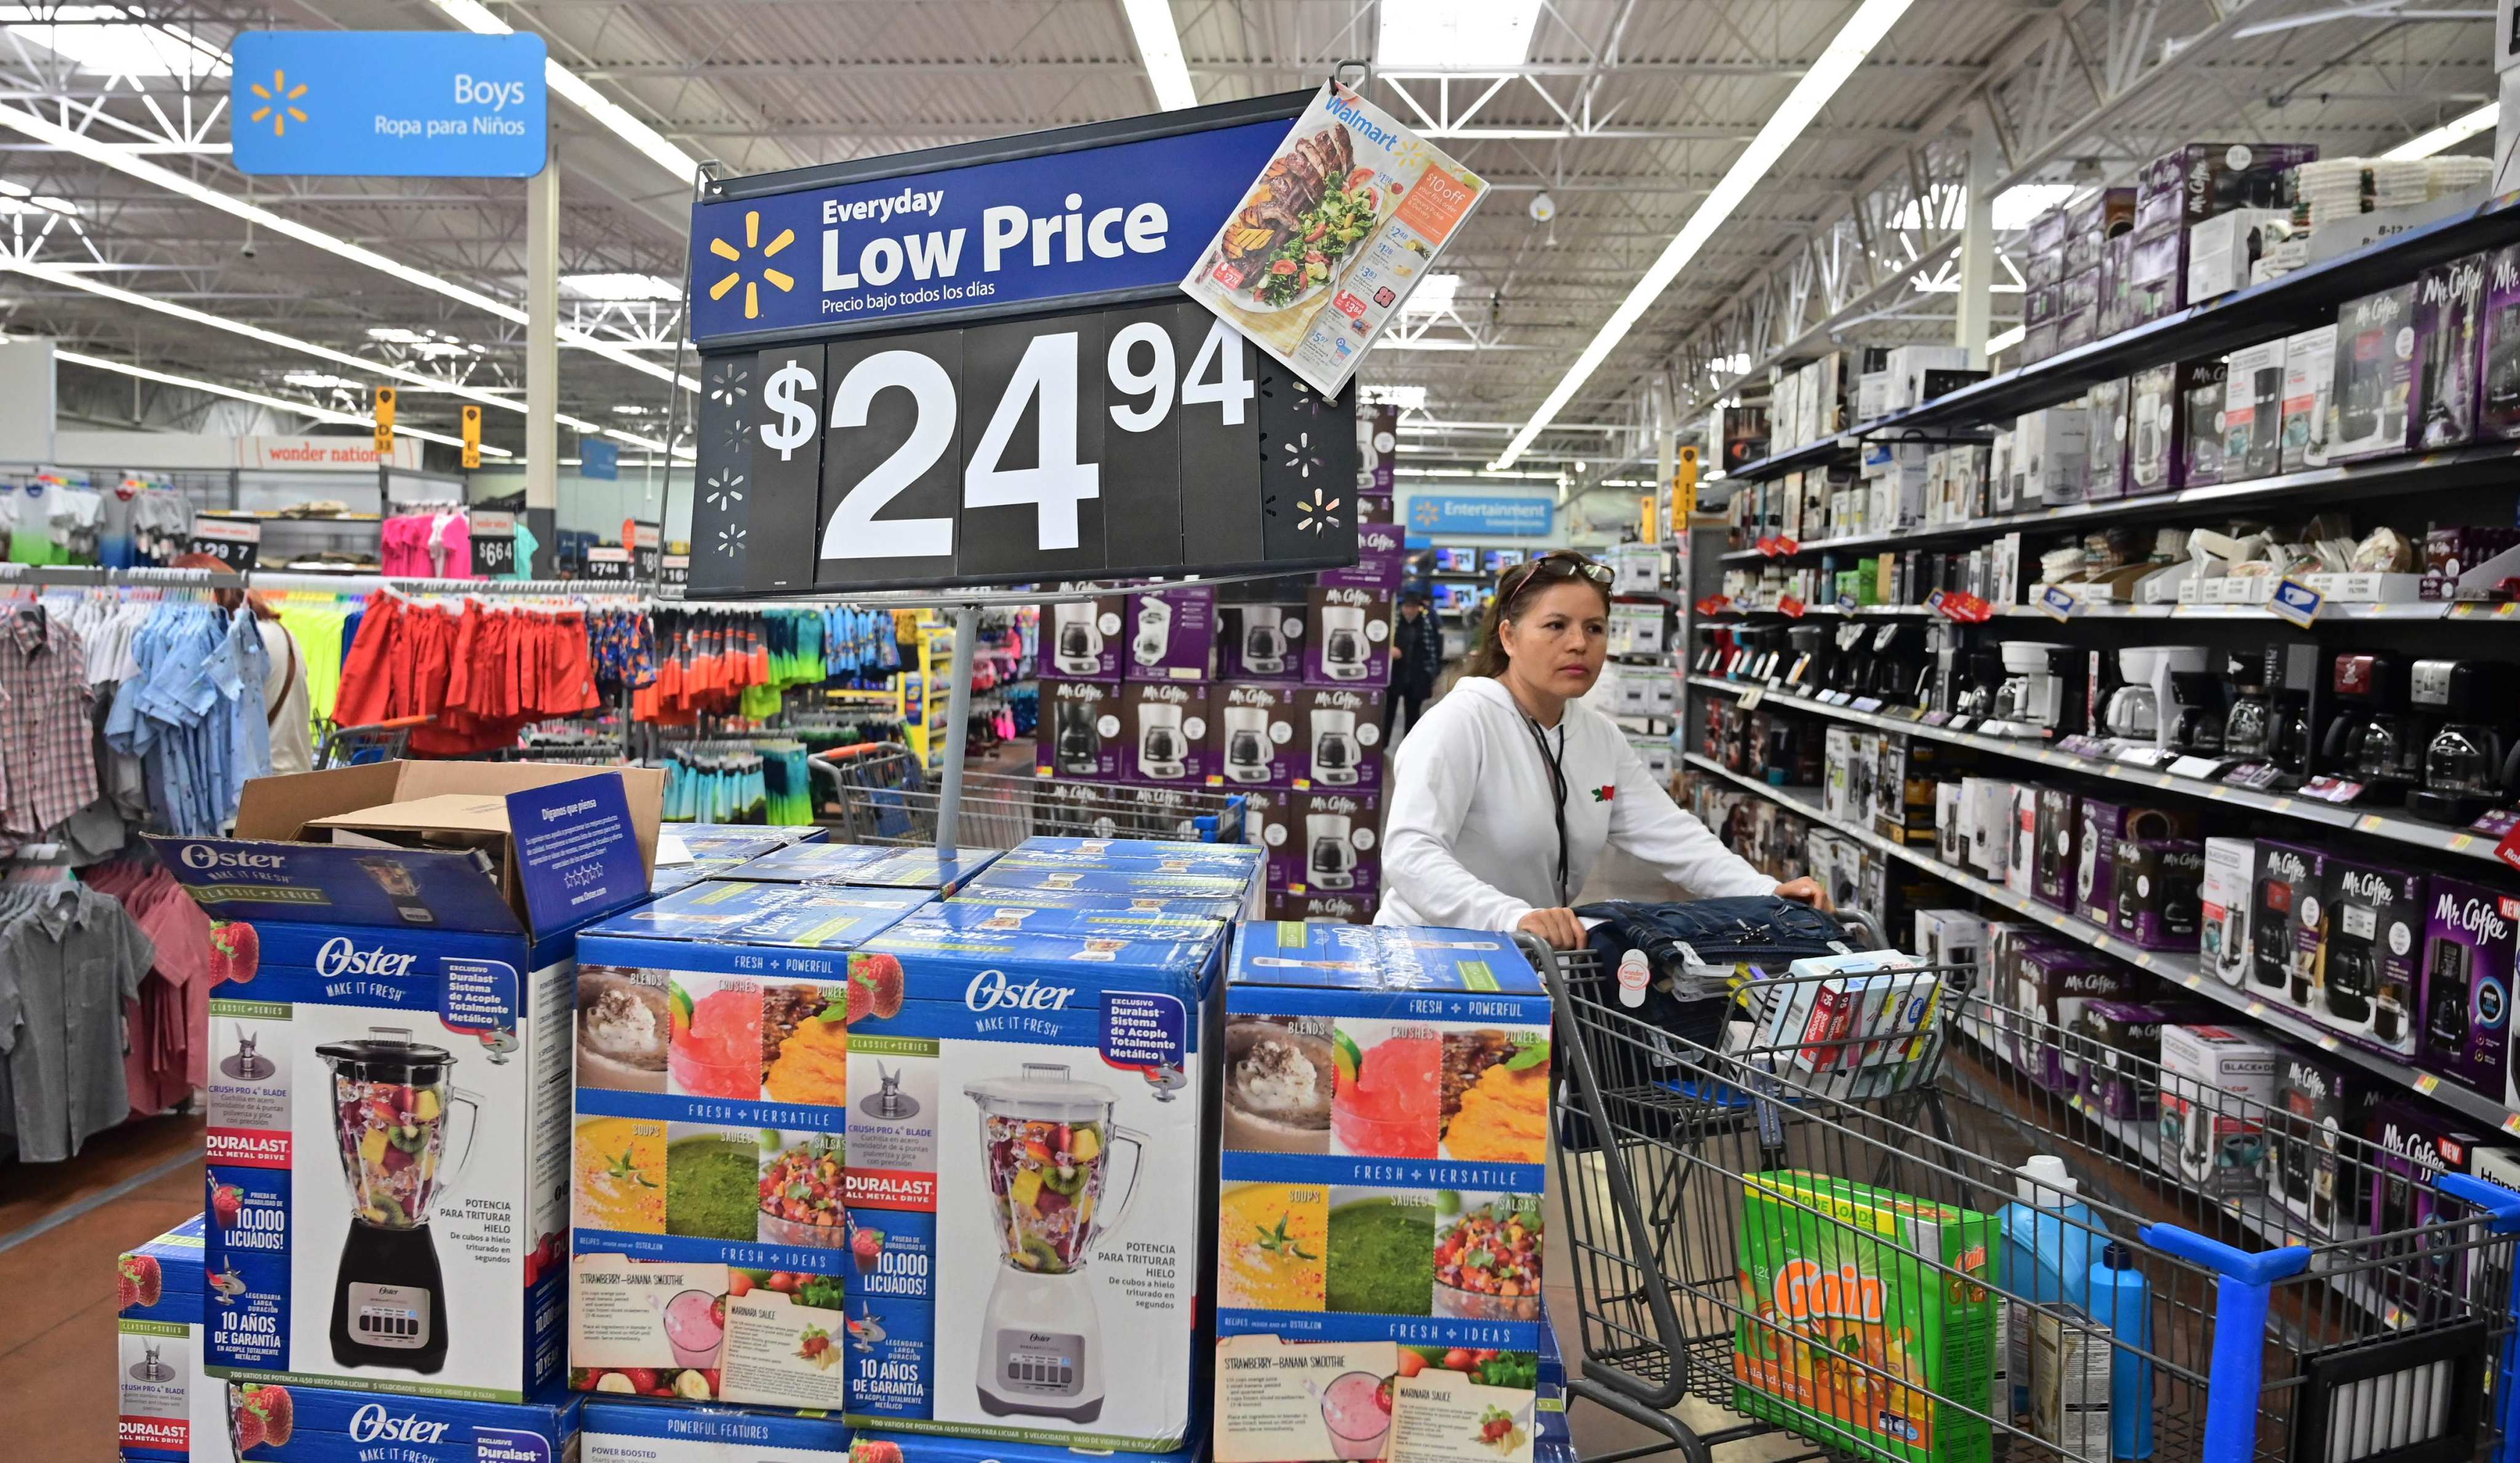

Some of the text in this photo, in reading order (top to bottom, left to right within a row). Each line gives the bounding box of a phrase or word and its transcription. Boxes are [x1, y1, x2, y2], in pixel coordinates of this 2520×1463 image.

[454, 73, 525, 112] Boys
[375, 116, 525, 138] Ropa para Niños
[1326, 93, 1397, 151] Walmart
[1426, 174, 1465, 204] $10 off
[823, 188, 944, 224] Everyday
[822, 193, 1169, 291] Low Price
[822, 281, 995, 315] Precio bajo todos los días
[377, 423, 390, 436] D
[377, 438, 392, 451] 33
[268, 445, 327, 463] wonder
[1444, 501, 1545, 517] Entertainment
[181, 844, 286, 870] Oster
[2282, 855, 2306, 884] Coffee
[2342, 872, 2394, 907] Mr. Coffee
[2435, 894, 2508, 944] Mr. Coffee
[315, 937, 418, 977] Oster
[735, 956, 833, 973] FRESH POWERFUL
[449, 965, 488, 973] EXCLUSIVO
[449, 972, 494, 984] Duralast
[630, 974, 663, 986] BLENDS
[2085, 975, 2118, 992] Coffee
[326, 982, 404, 1002] MAKE IT FRESH
[449, 983, 491, 993] Sistema
[965, 969, 1076, 1012] Oster
[449, 993, 502, 1004] de Acople
[1823, 993, 1833, 1007] 95
[449, 1002, 508, 1014] Totalmente
[1410, 1000, 1522, 1017] FRESH POWERFUL
[449, 1013, 494, 1024] Metálico
[977, 1017, 1060, 1036] MAKE IT FRESH
[1809, 1009, 1822, 1040] Storage
[1288, 1022, 1325, 1035] BLENDS
[852, 1041, 928, 1052] CLASSIC SERIES
[2303, 1065, 2326, 1097] Coffee
[689, 1105, 830, 1125] FRESH VERSATILE
[633, 1124, 660, 1137] SOUPS
[848, 1124, 875, 1133] CRUSH
[878, 1126, 894, 1134] PRO
[906, 1128, 932, 1137] BLADE
[207, 1136, 287, 1153] DURALAST
[2441, 1140, 2462, 1161] NEW
[227, 1150, 254, 1159] METAL
[257, 1152, 285, 1160] DRIVE
[1354, 1165, 1518, 1185] FRESH VERSATILE
[846, 1176, 933, 1195] DURALAST
[465, 1199, 511, 1211] POTENCIA
[866, 1193, 898, 1201] METAL
[1288, 1190, 1319, 1203] SOUPS
[1499, 1199, 1537, 1212] SALSAS
[236, 1209, 284, 1233] 10,000
[440, 1209, 511, 1222] PARA TRITURAR
[483, 1224, 510, 1233] HIELO
[225, 1230, 284, 1249] LICUADOS!
[462, 1233, 481, 1241] cubos
[491, 1235, 511, 1244] hielo
[466, 1244, 500, 1253] triturado
[474, 1254, 511, 1264] segundos
[722, 1249, 827, 1267] FRESH IDEAS
[876, 1253, 927, 1278] 10,000
[378, 1285, 398, 1296] Oster
[864, 1275, 927, 1296] LICUADOS!
[1774, 1259, 1887, 1323] Gain
[246, 1293, 281, 1301] LEGENDARIA
[222, 1312, 276, 1333] 10 AÑOS
[215, 1331, 281, 1349] DE GARANTÍA
[1030, 1333, 1051, 1343] Oster
[1390, 1324, 1511, 1342] FRESH IDEAS
[860, 1360, 918, 1381] 10 AÑOS
[854, 1380, 924, 1397] DE GARANTÍA
[349, 1403, 450, 1444] Oster
[668, 1419, 768, 1439] POWERFUL FEATURES
[478, 1446, 535, 1462] Duralast
[592, 1446, 656, 1458] POWER BOOSTED
